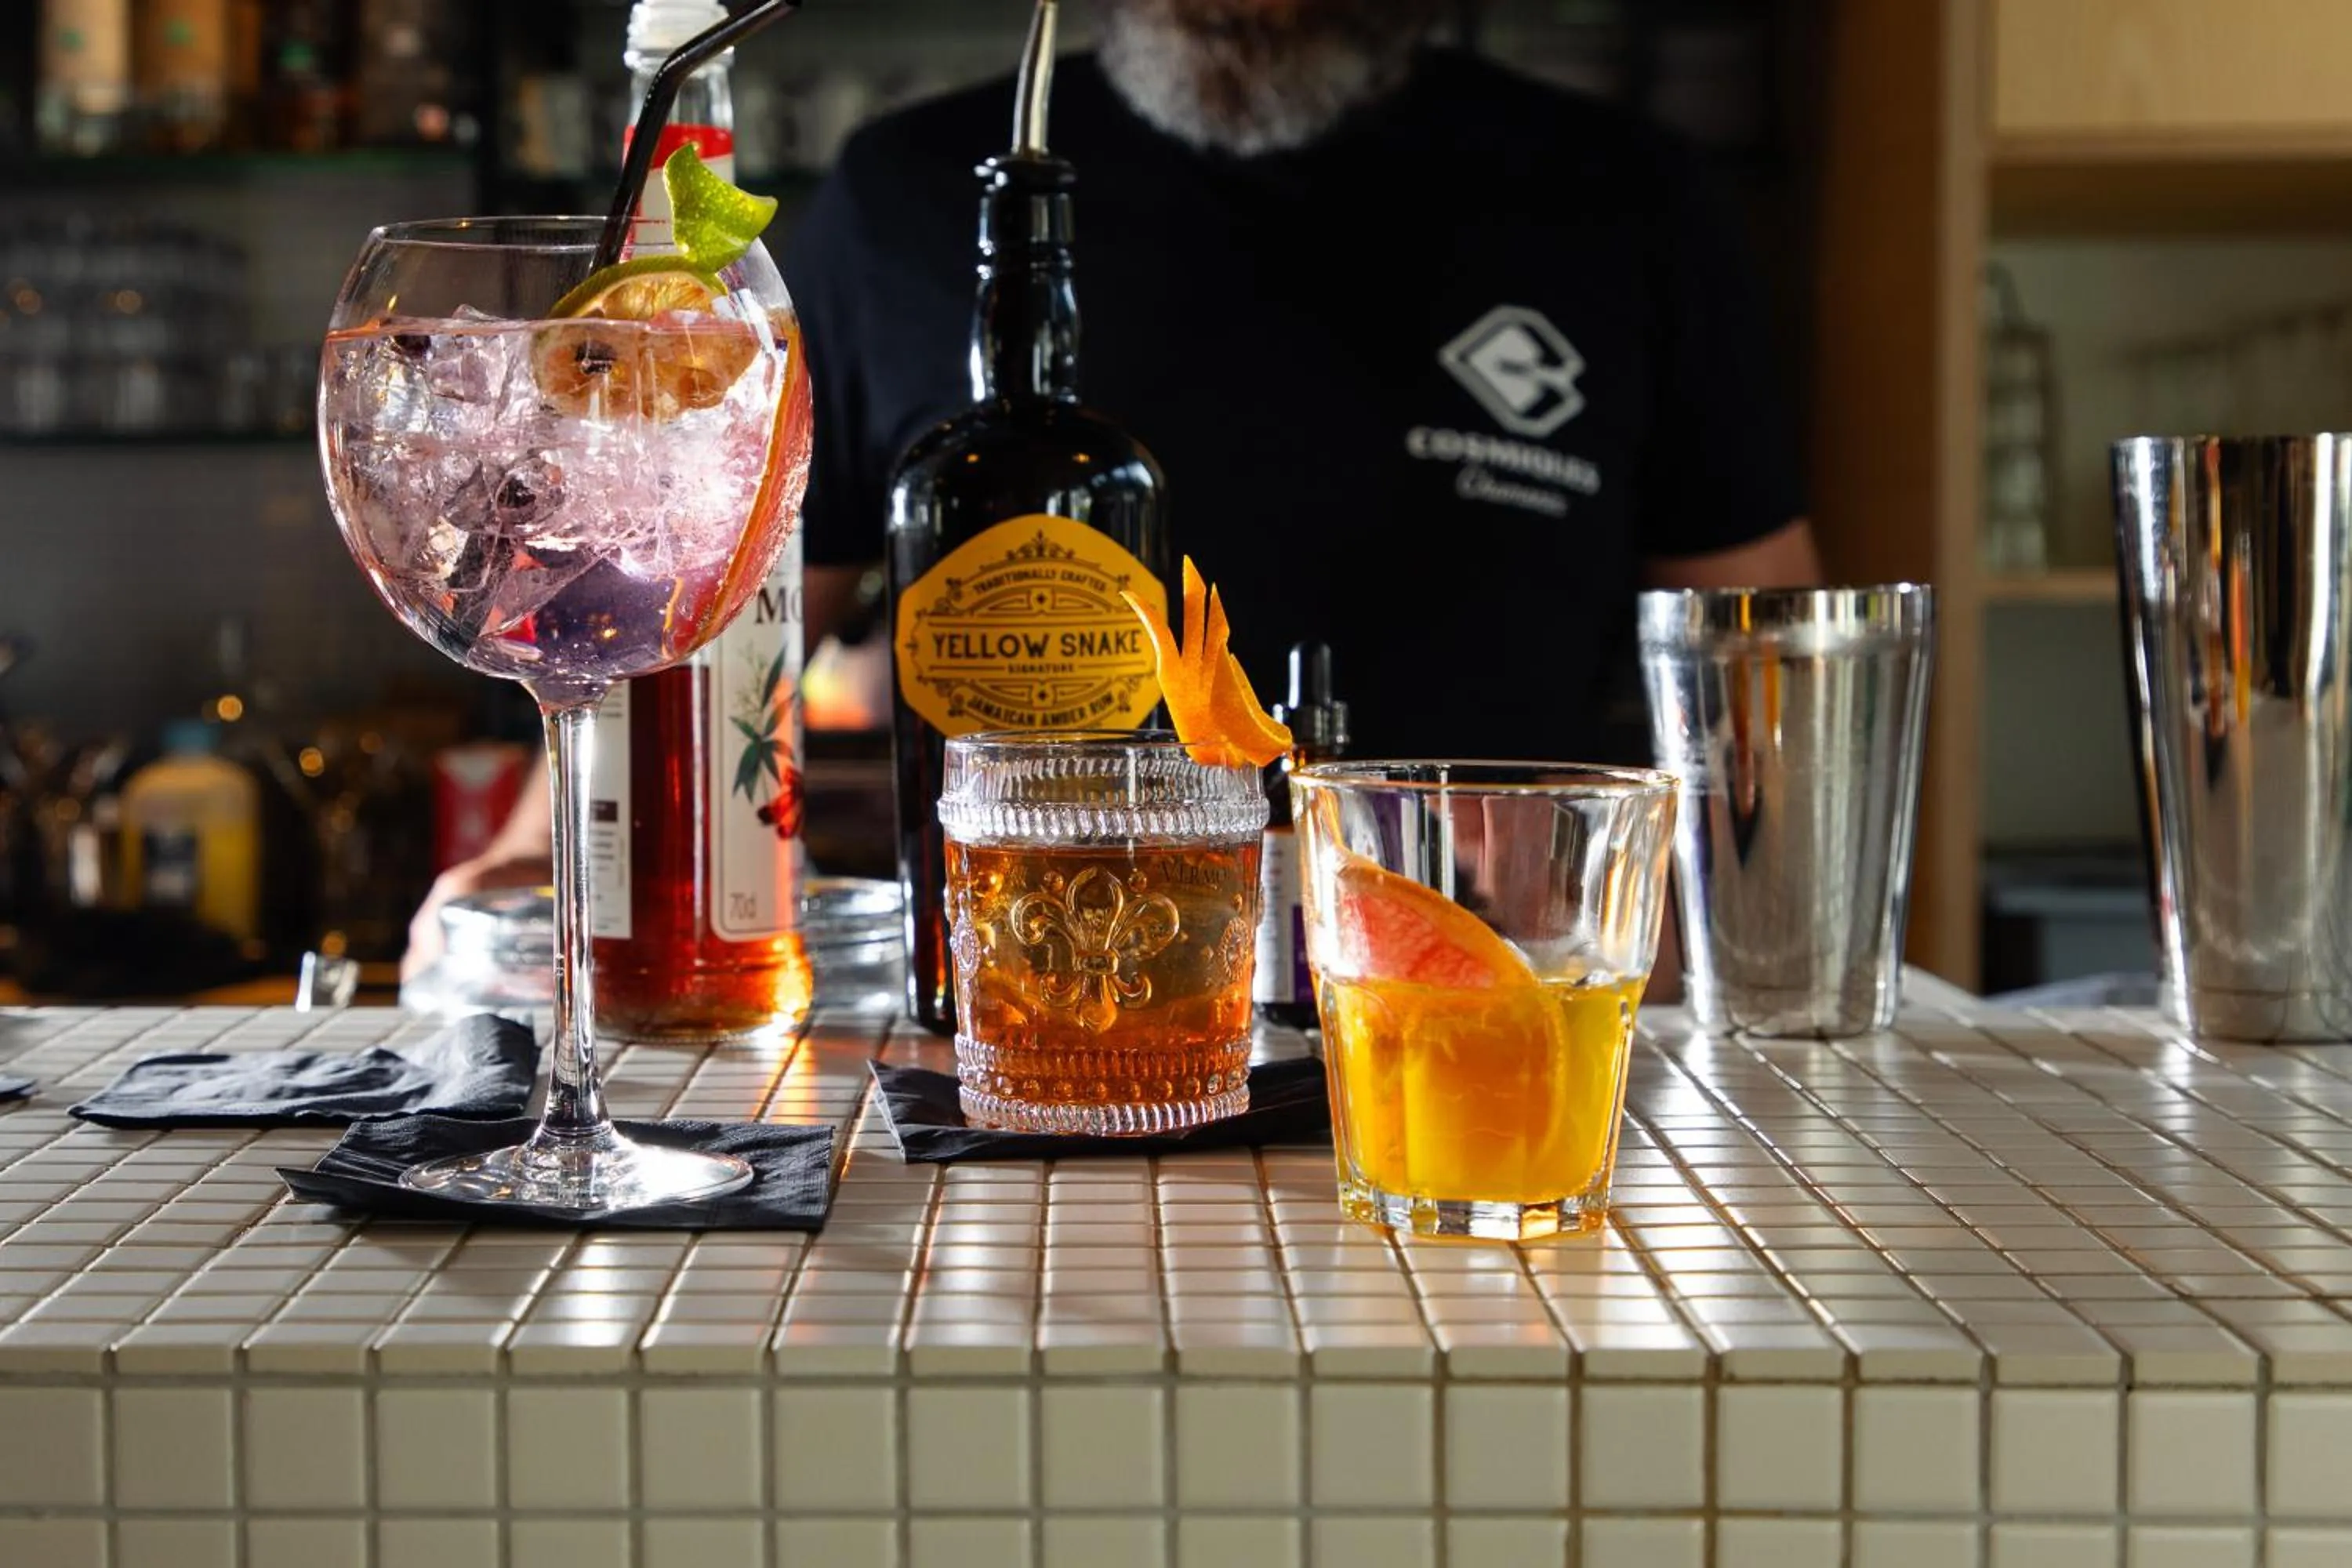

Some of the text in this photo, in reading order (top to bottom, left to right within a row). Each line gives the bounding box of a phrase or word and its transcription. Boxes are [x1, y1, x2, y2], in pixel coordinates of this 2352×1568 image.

[973, 569, 1106, 593] TRADITIONALLY CRAFTED
[932, 629, 1142, 659] YELLOW SNAKE
[1007, 662, 1075, 674] SIGNATURE
[967, 692, 1114, 727] JAMAICAN AMBER RUM
